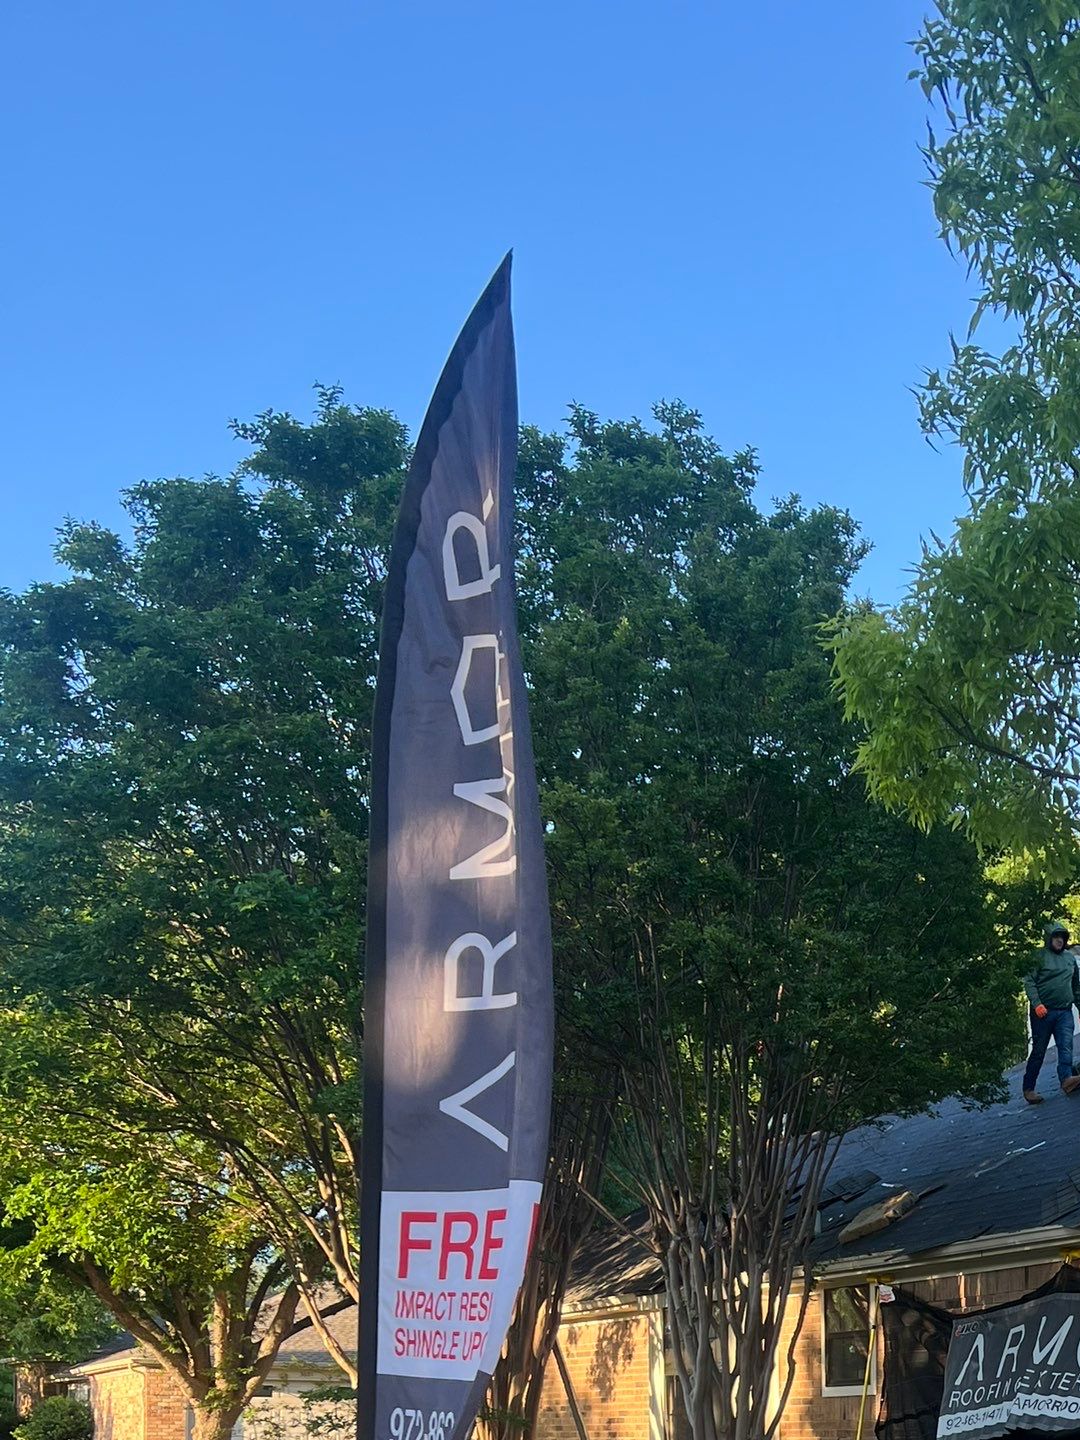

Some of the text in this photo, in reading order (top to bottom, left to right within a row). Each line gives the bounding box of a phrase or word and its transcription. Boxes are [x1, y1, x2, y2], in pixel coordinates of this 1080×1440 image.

[397, 1203, 541, 1280] FRE
[395, 1290, 456, 1321] IMPACT
[394, 1328, 460, 1360] SHINGLE
